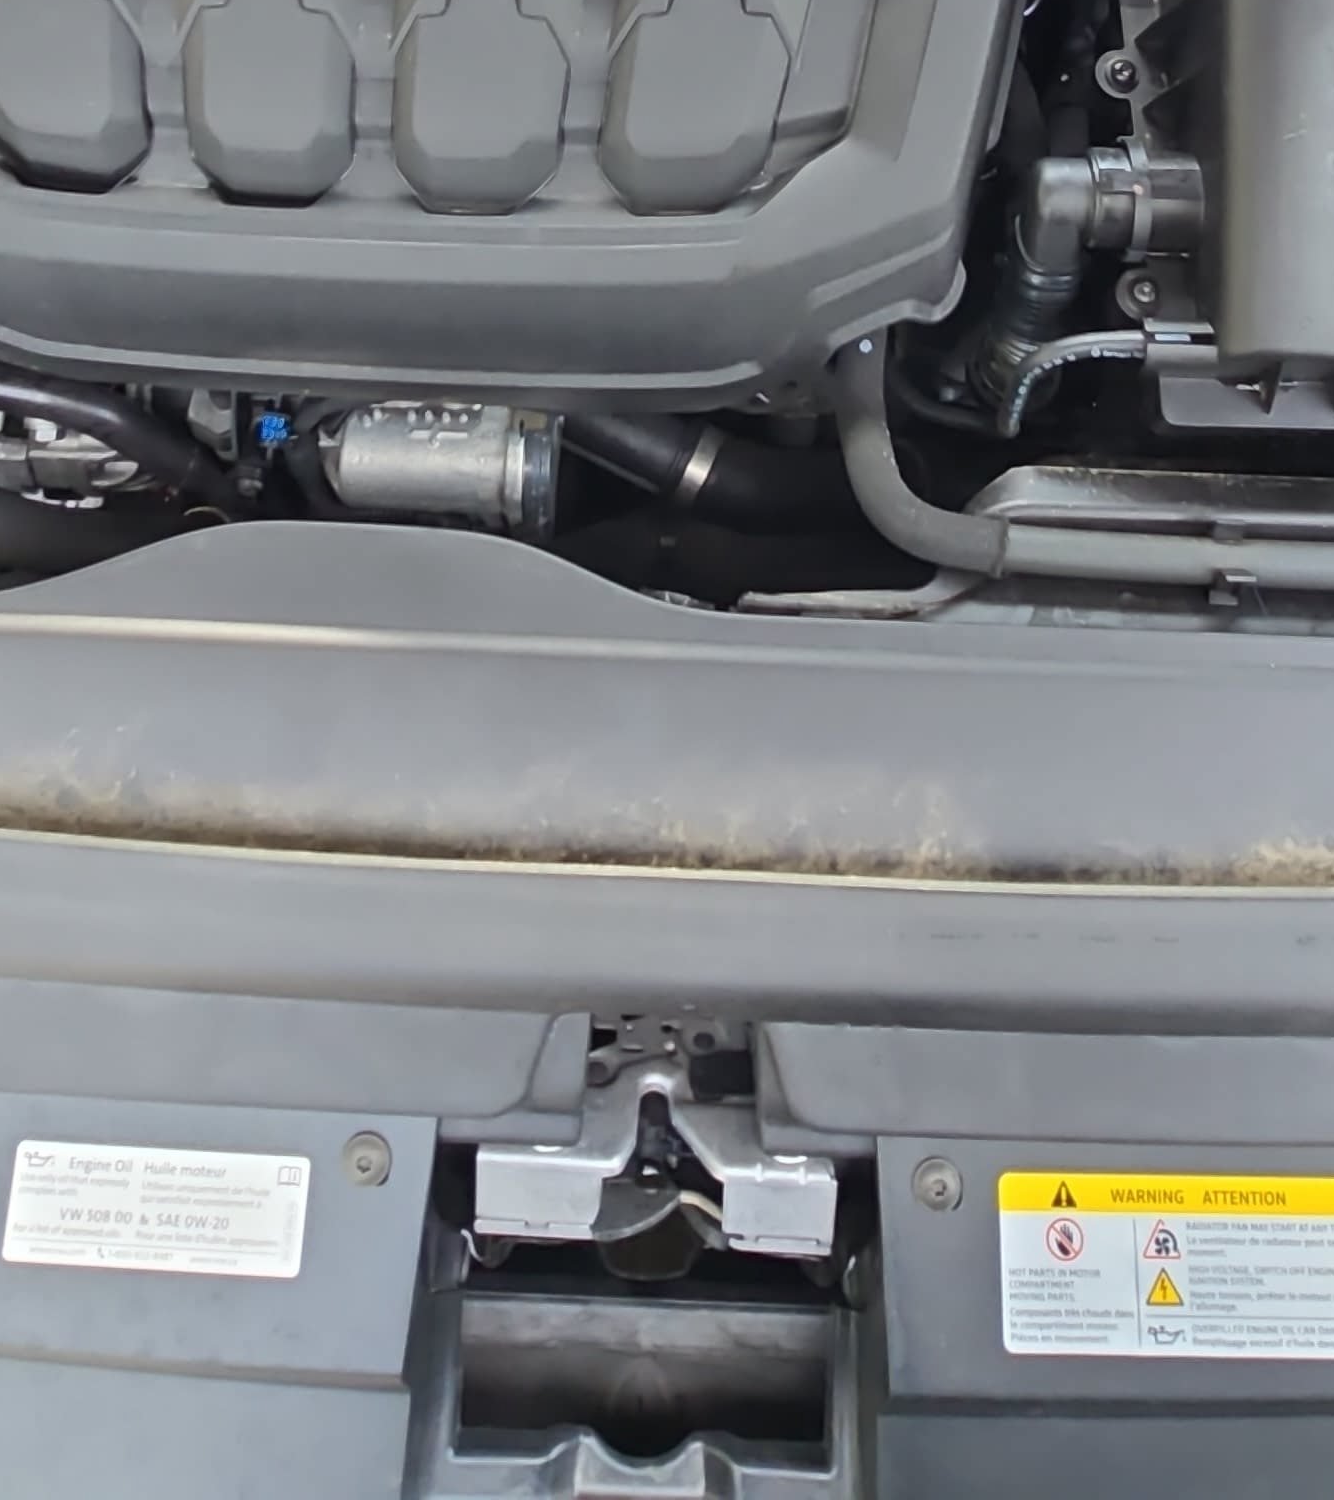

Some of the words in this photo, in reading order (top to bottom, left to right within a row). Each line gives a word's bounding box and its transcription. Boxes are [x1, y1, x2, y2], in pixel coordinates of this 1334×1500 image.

[68, 1156, 112, 1174] Engine
[114, 1158, 133, 1172] Oil
[143, 1161, 177, 1176] Huile
[179, 1165, 227, 1179] moteur
[1110, 1188, 1184, 1205] WARNING
[1202, 1189, 1287, 1206] ATTENTION
[59, 1206, 84, 1221] VW
[86, 1208, 112, 1223] 508
[114, 1209, 133, 1225] 00
[139, 1212, 150, 1226] &
[156, 1212, 180, 1228] SAE
[184, 1214, 230, 1231] 0W-20
[1186, 1221, 1228, 1231] RADIATOR
[1230, 1222, 1248, 1231] FAN
[1269, 1223, 1295, 1232] START
[1297, 1224, 1310, 1233] AT
[1311, 1224, 1328, 1233] ANY
[1009, 1268, 1028, 1277] HOT
[1029, 1268, 1055, 1278] PARTS
[1058, 1269, 1067, 1278] IN
[1069, 1269, 1101, 1278] MOTOR
[1009, 1280, 1075, 1290] COMPARTMENT
